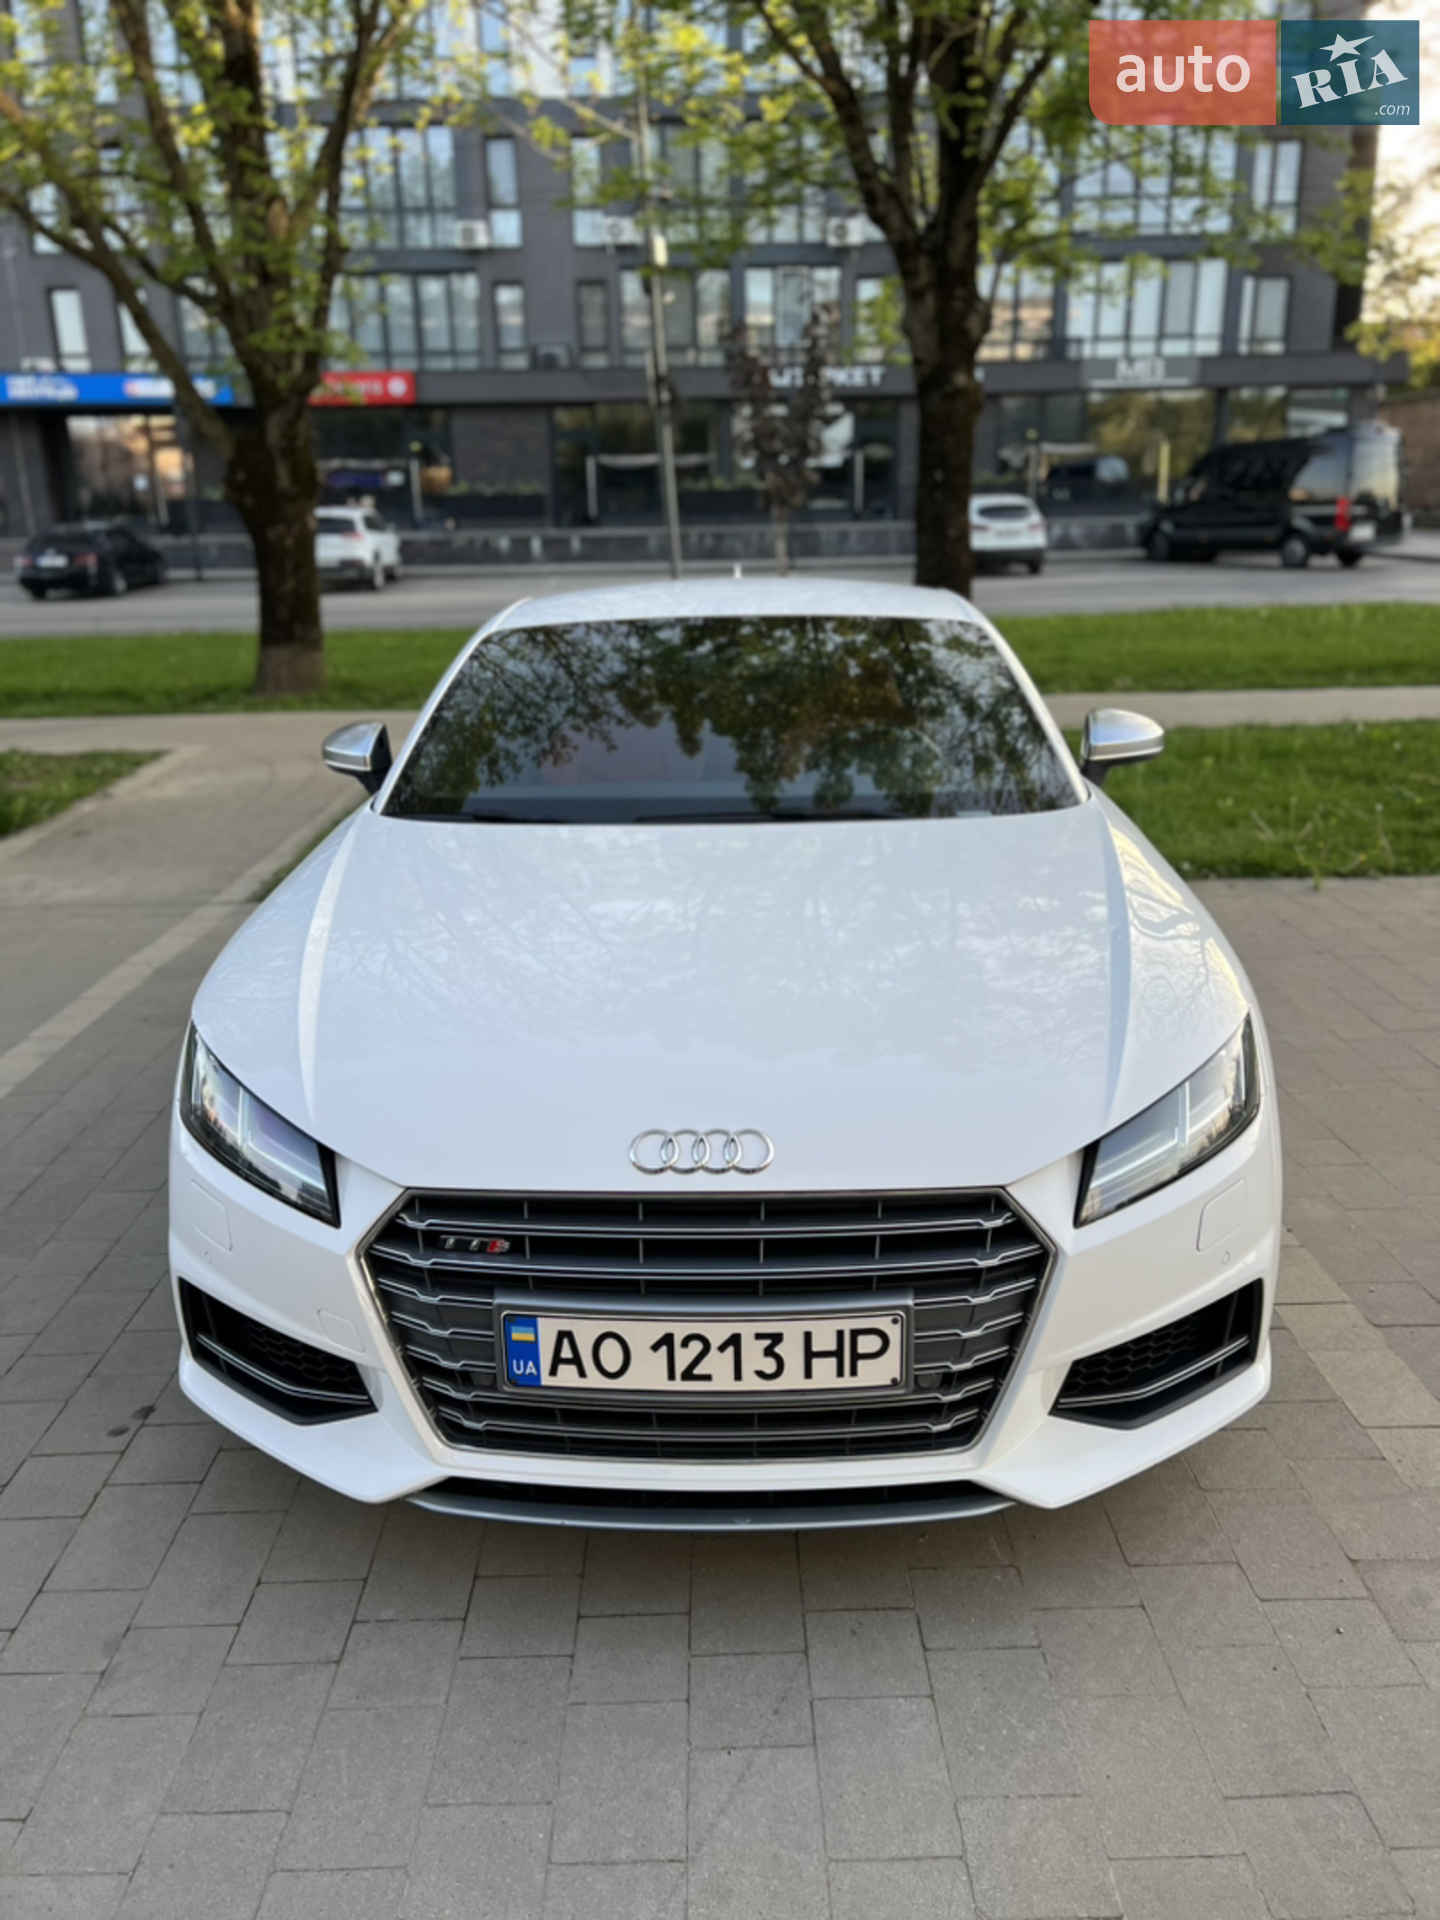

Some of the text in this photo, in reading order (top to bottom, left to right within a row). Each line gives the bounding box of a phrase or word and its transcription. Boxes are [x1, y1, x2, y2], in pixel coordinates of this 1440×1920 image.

[440, 1235, 511, 1253] TTS
[548, 1327, 891, 1382] AO 1213 HP
[512, 1359, 538, 1377] UA
